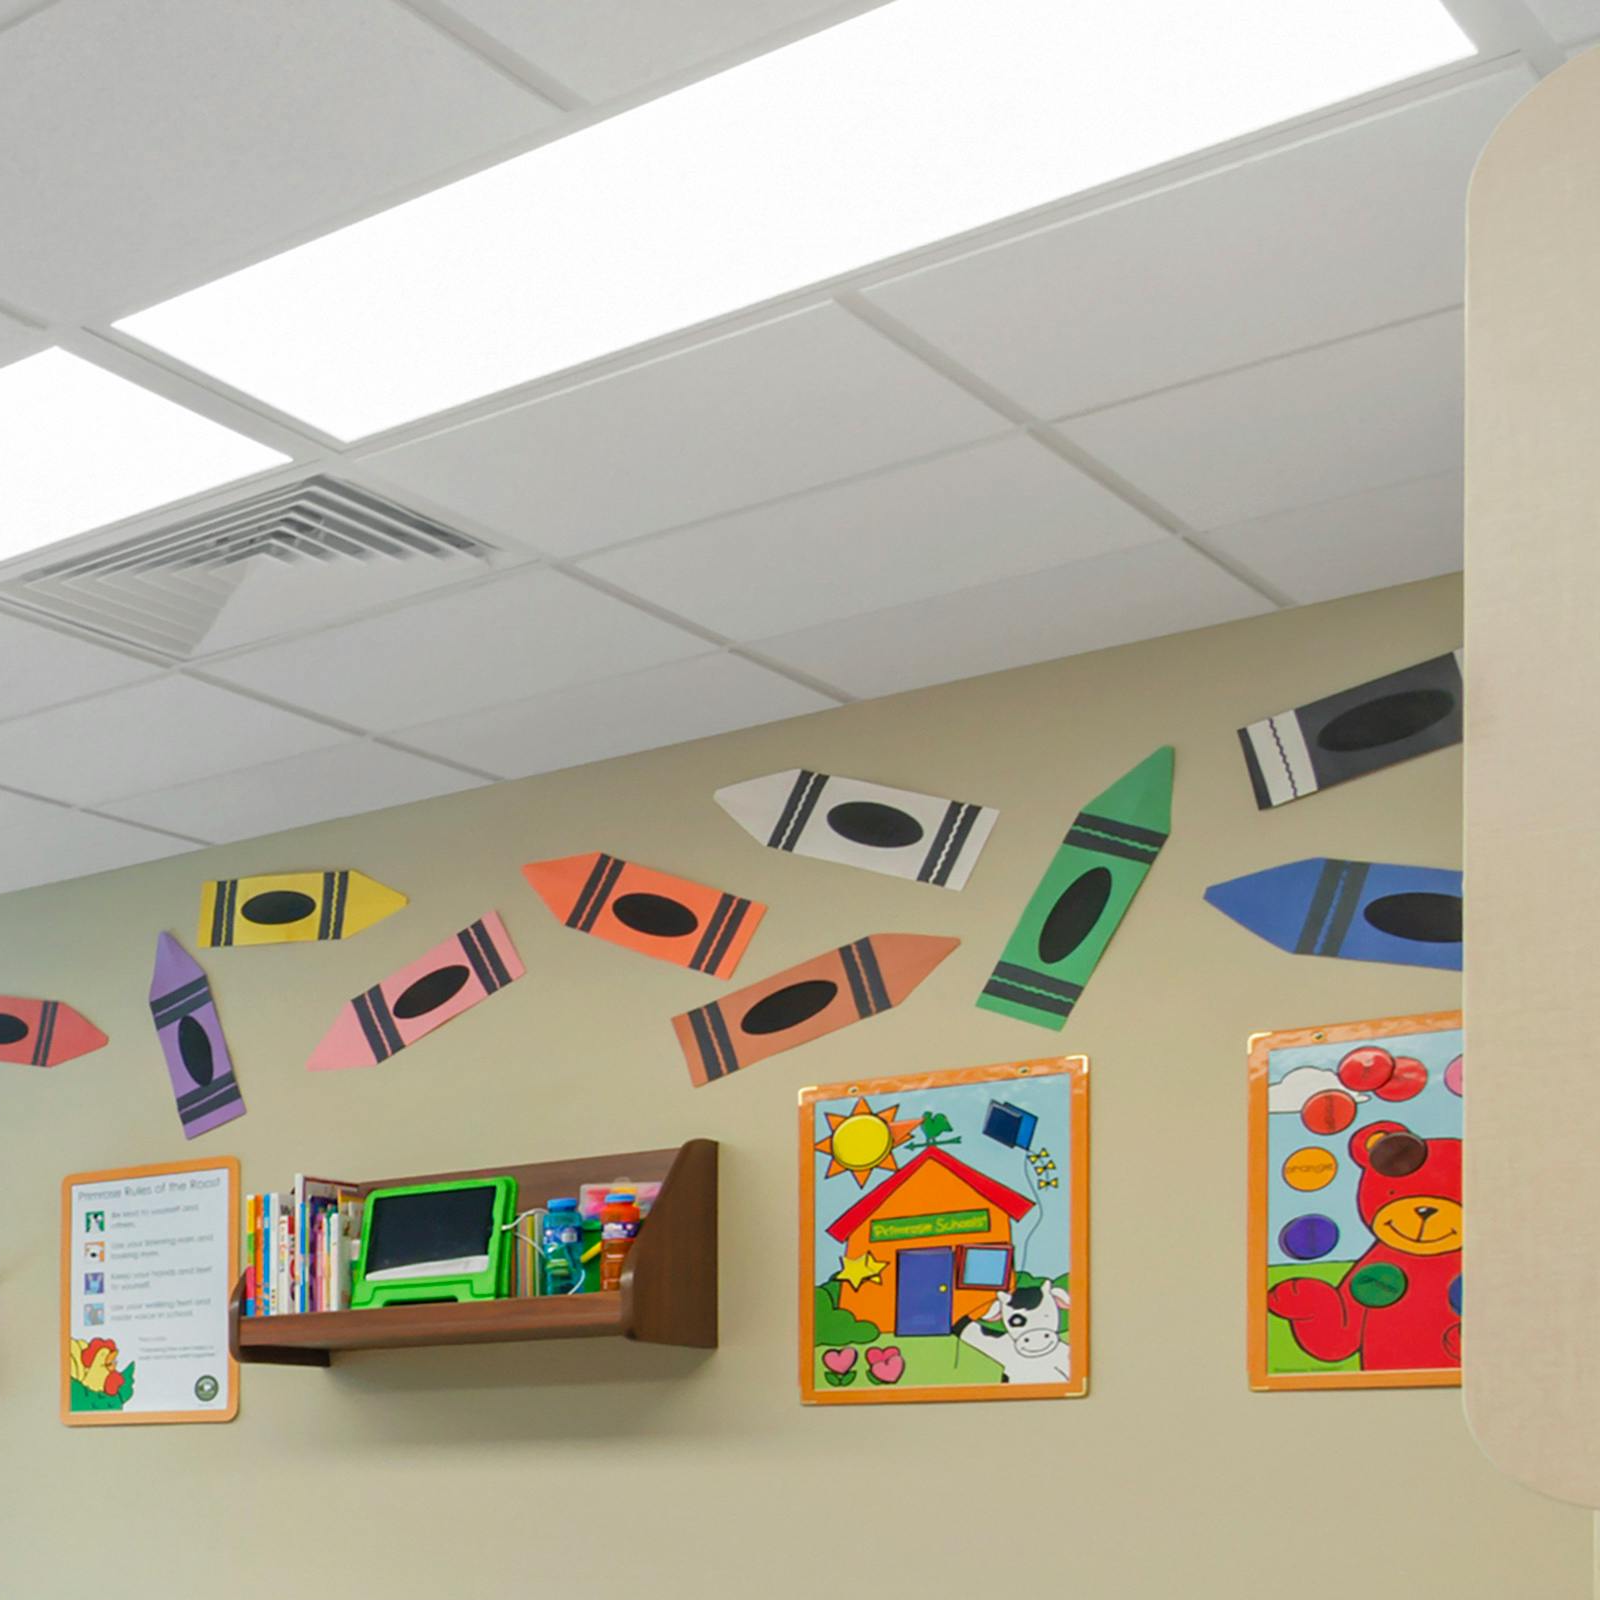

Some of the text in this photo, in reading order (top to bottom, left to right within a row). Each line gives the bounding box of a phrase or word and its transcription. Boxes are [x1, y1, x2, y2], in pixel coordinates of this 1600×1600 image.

[78, 1178, 221, 1201] Primrose Rules of the Roost
